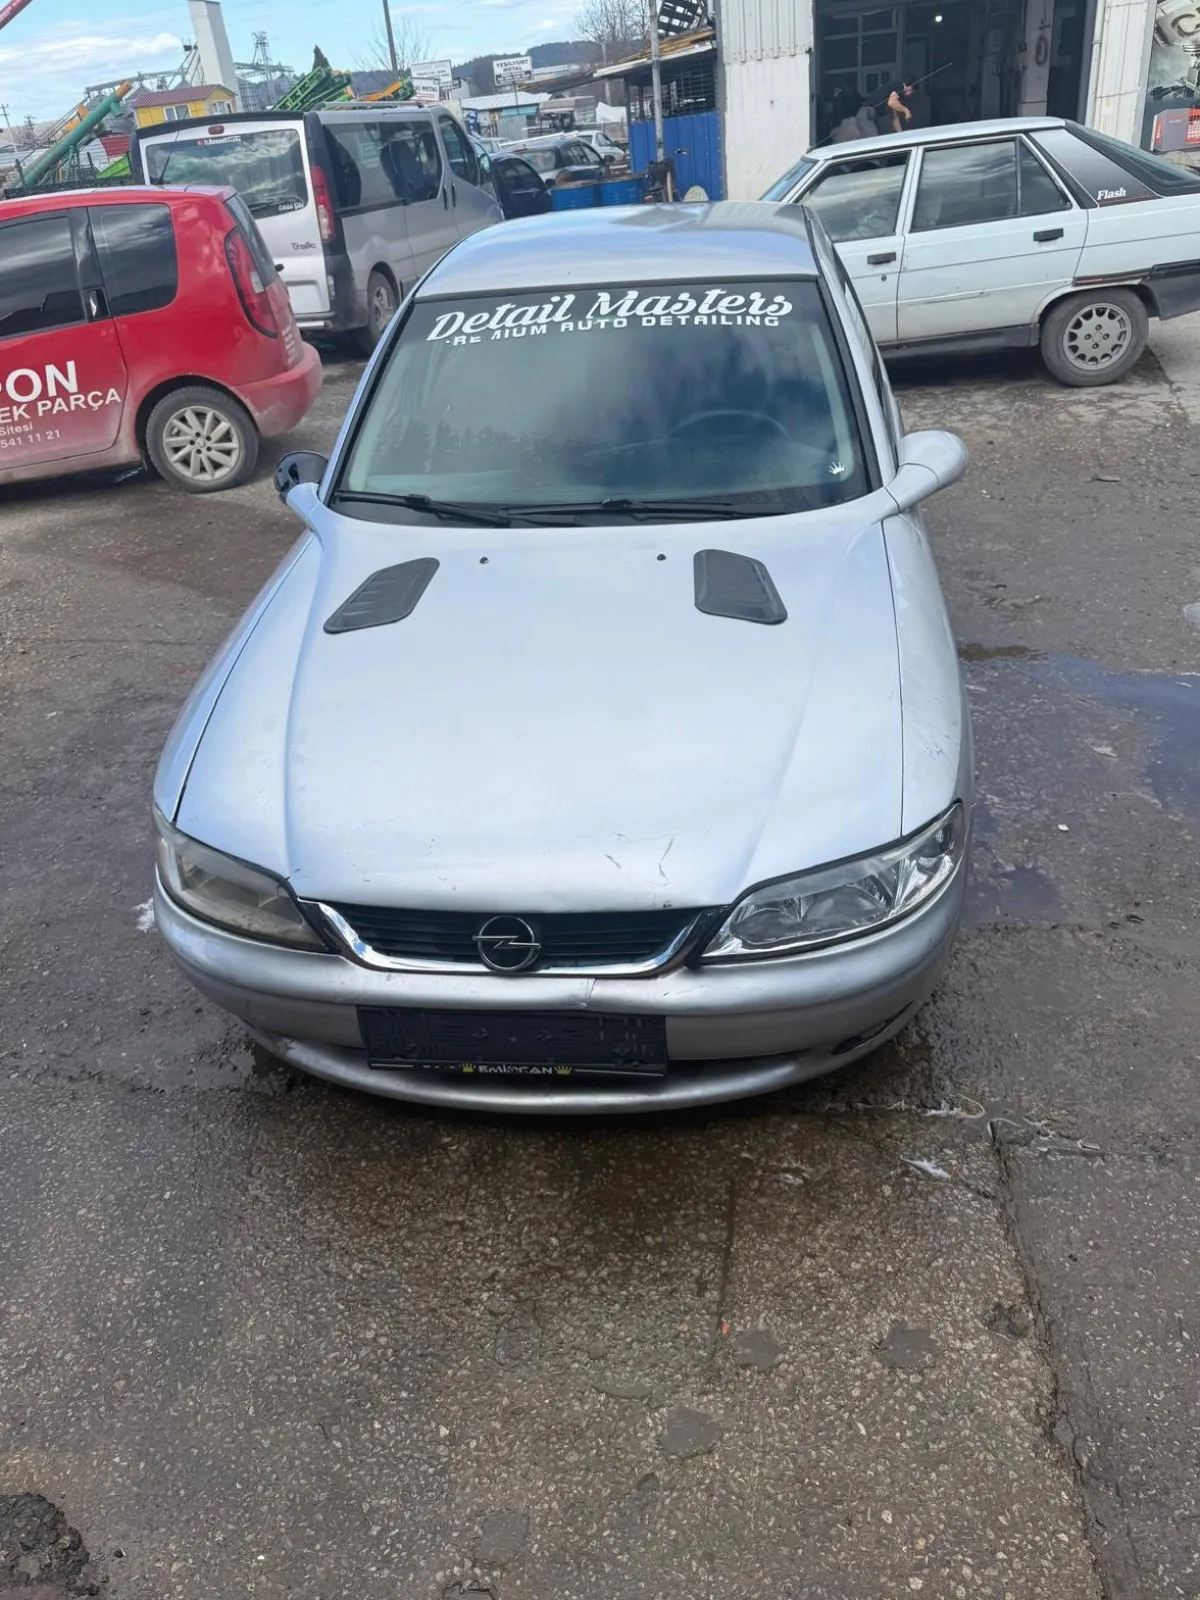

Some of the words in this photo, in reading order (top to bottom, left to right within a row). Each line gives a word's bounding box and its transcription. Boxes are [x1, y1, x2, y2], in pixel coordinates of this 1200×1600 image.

[1097, 187, 1127, 201] Flash
[425, 294, 576, 341] Detail
[586, 289, 793, 319] Masters
[560, 318, 628, 332] AUTO
[641, 315, 780, 327] DETAILING
[0, 360, 79, 403] ON
[37, 388, 122, 417] PARÇA
[45, 428, 61, 441] 21
